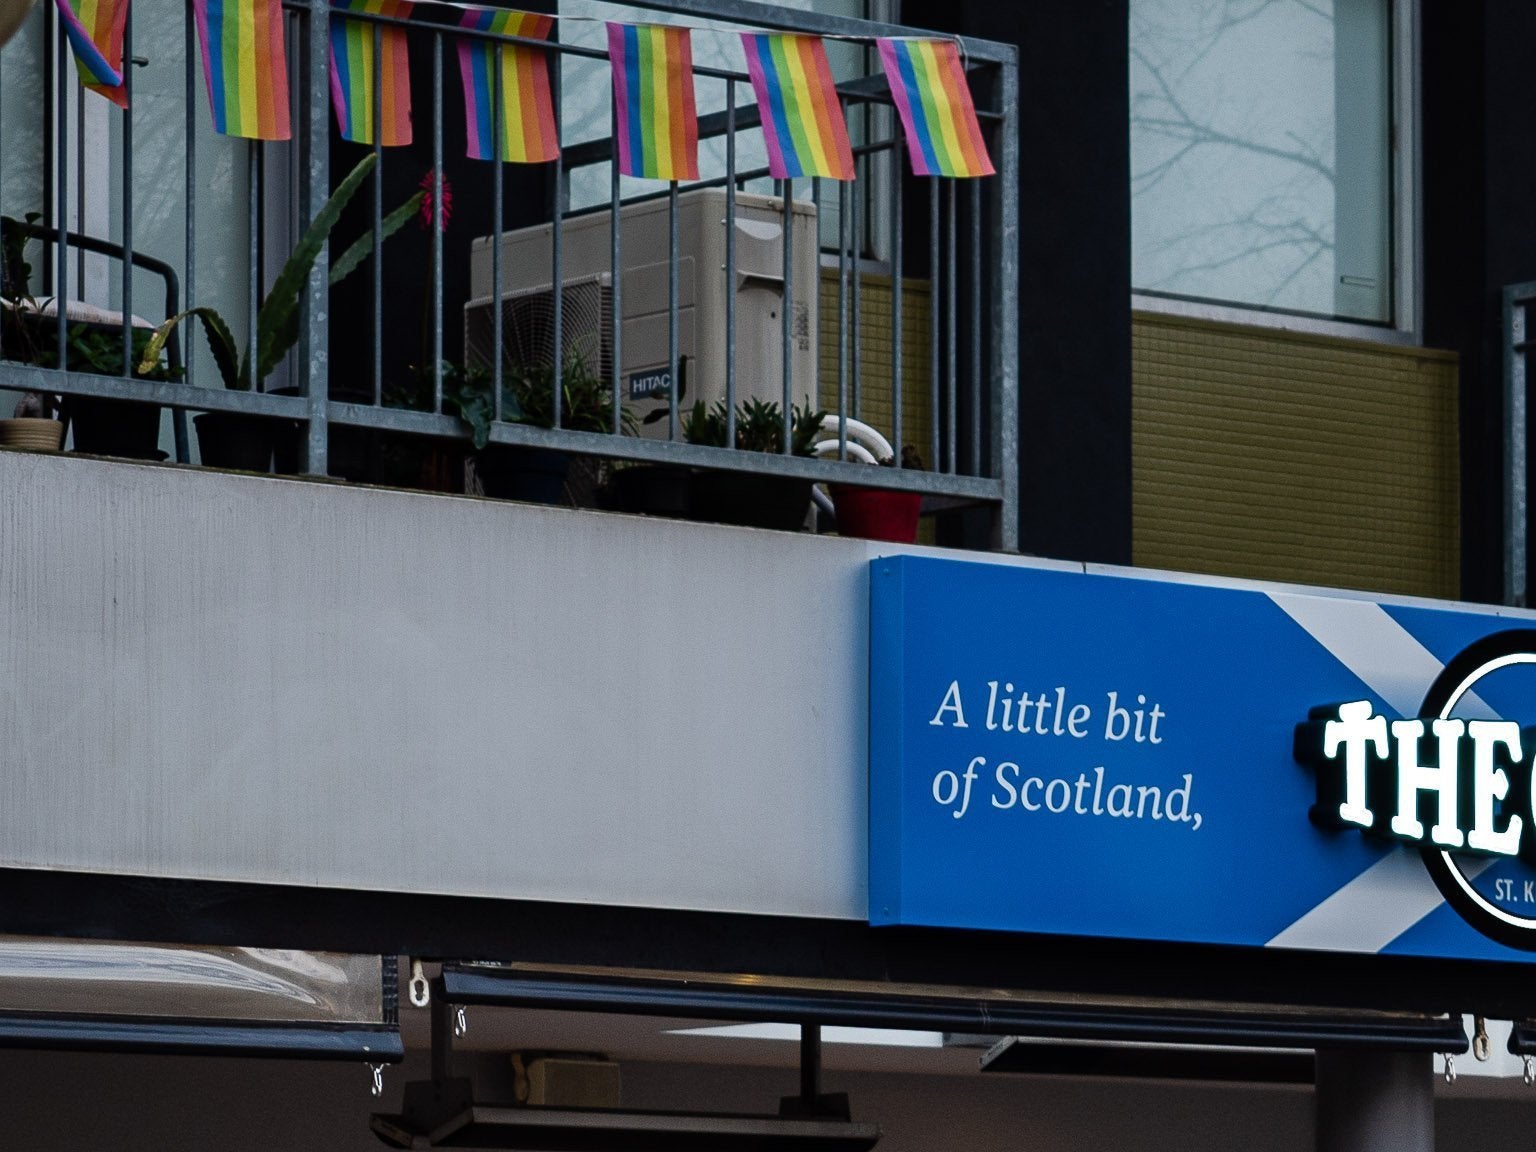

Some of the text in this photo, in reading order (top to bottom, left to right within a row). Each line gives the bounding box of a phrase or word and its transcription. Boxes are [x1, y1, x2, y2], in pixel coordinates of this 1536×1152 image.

[633, 373, 675, 393] HITAC
[929, 680, 1166, 745] A little bit
[932, 756, 1204, 830] of Scotland,
[1495, 878, 1518, 903] ST.
